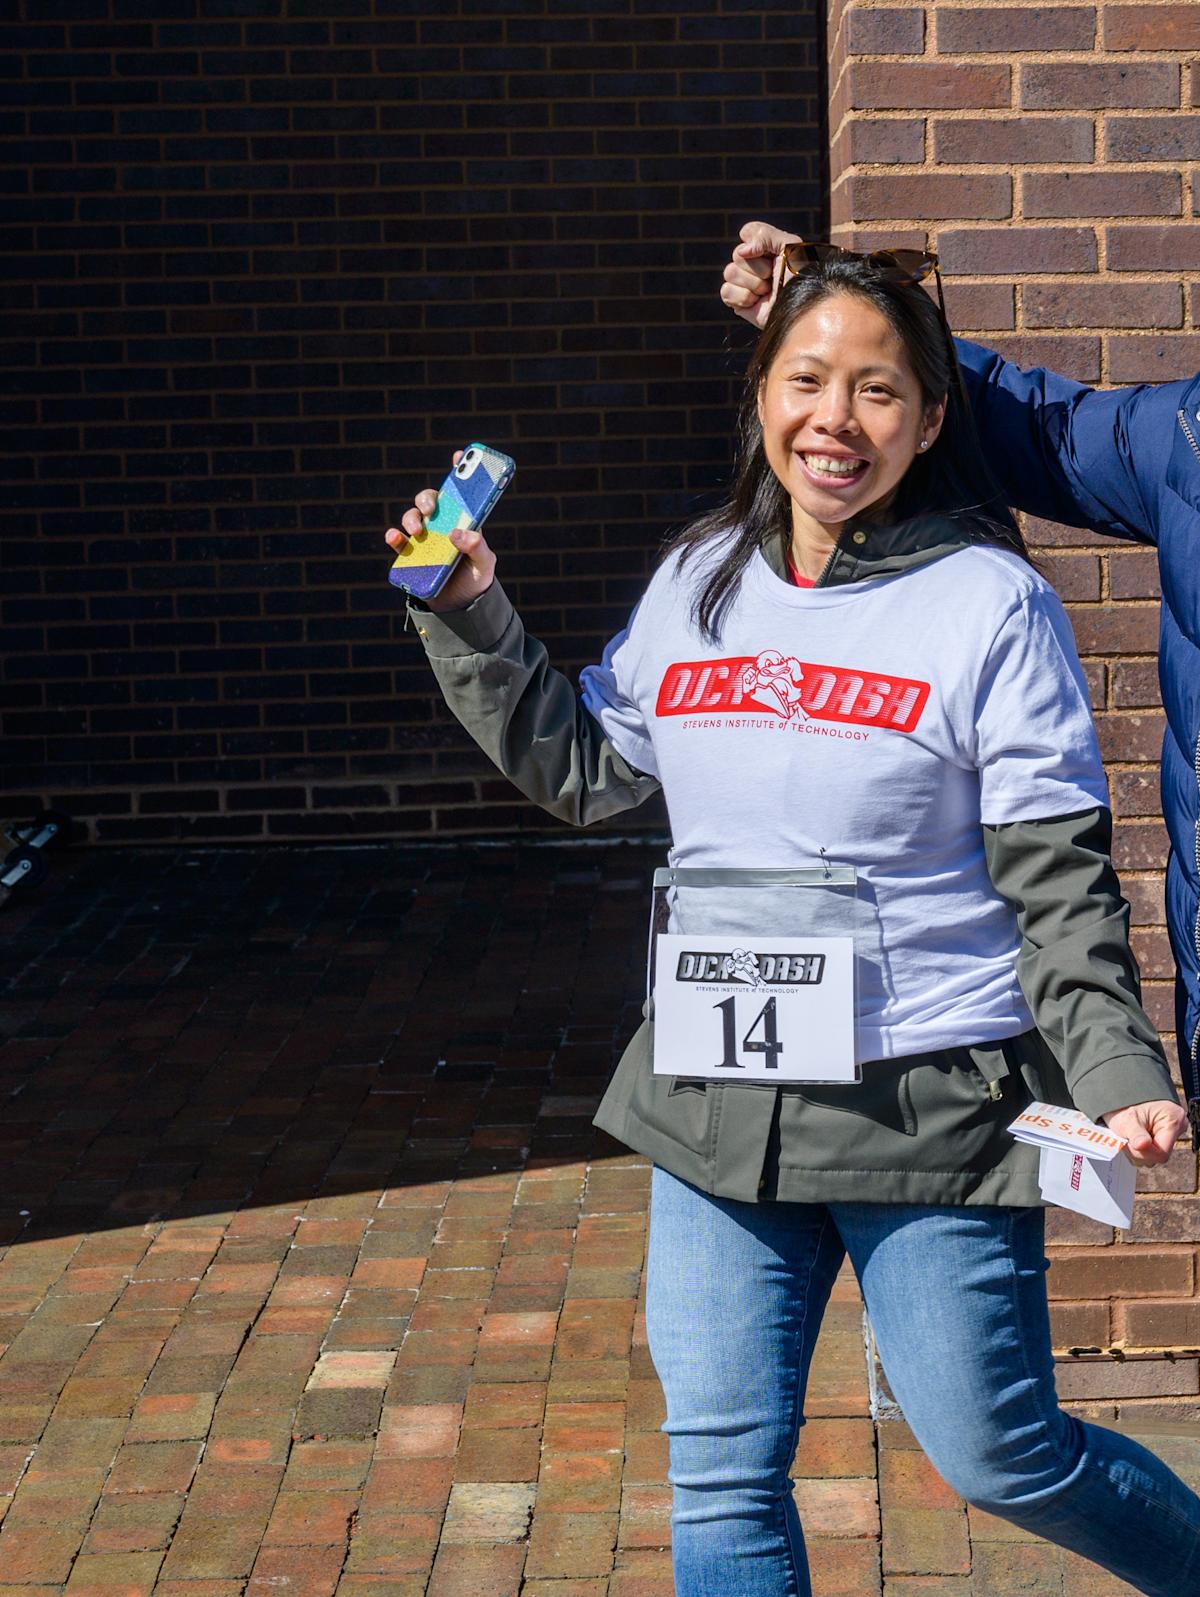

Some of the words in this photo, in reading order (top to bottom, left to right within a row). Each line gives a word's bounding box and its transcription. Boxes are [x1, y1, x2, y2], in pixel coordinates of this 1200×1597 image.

[664, 663, 753, 710] DUCK
[801, 672, 921, 726] DASH
[682, 719, 723, 730] STEVENS
[725, 718, 775, 730] INSTITUTE
[778, 721, 789, 732] of
[791, 723, 870, 741] TECHNOLOGY
[678, 954, 732, 980] DUCK
[759, 956, 822, 982] DASH
[712, 995, 784, 1069] 14
